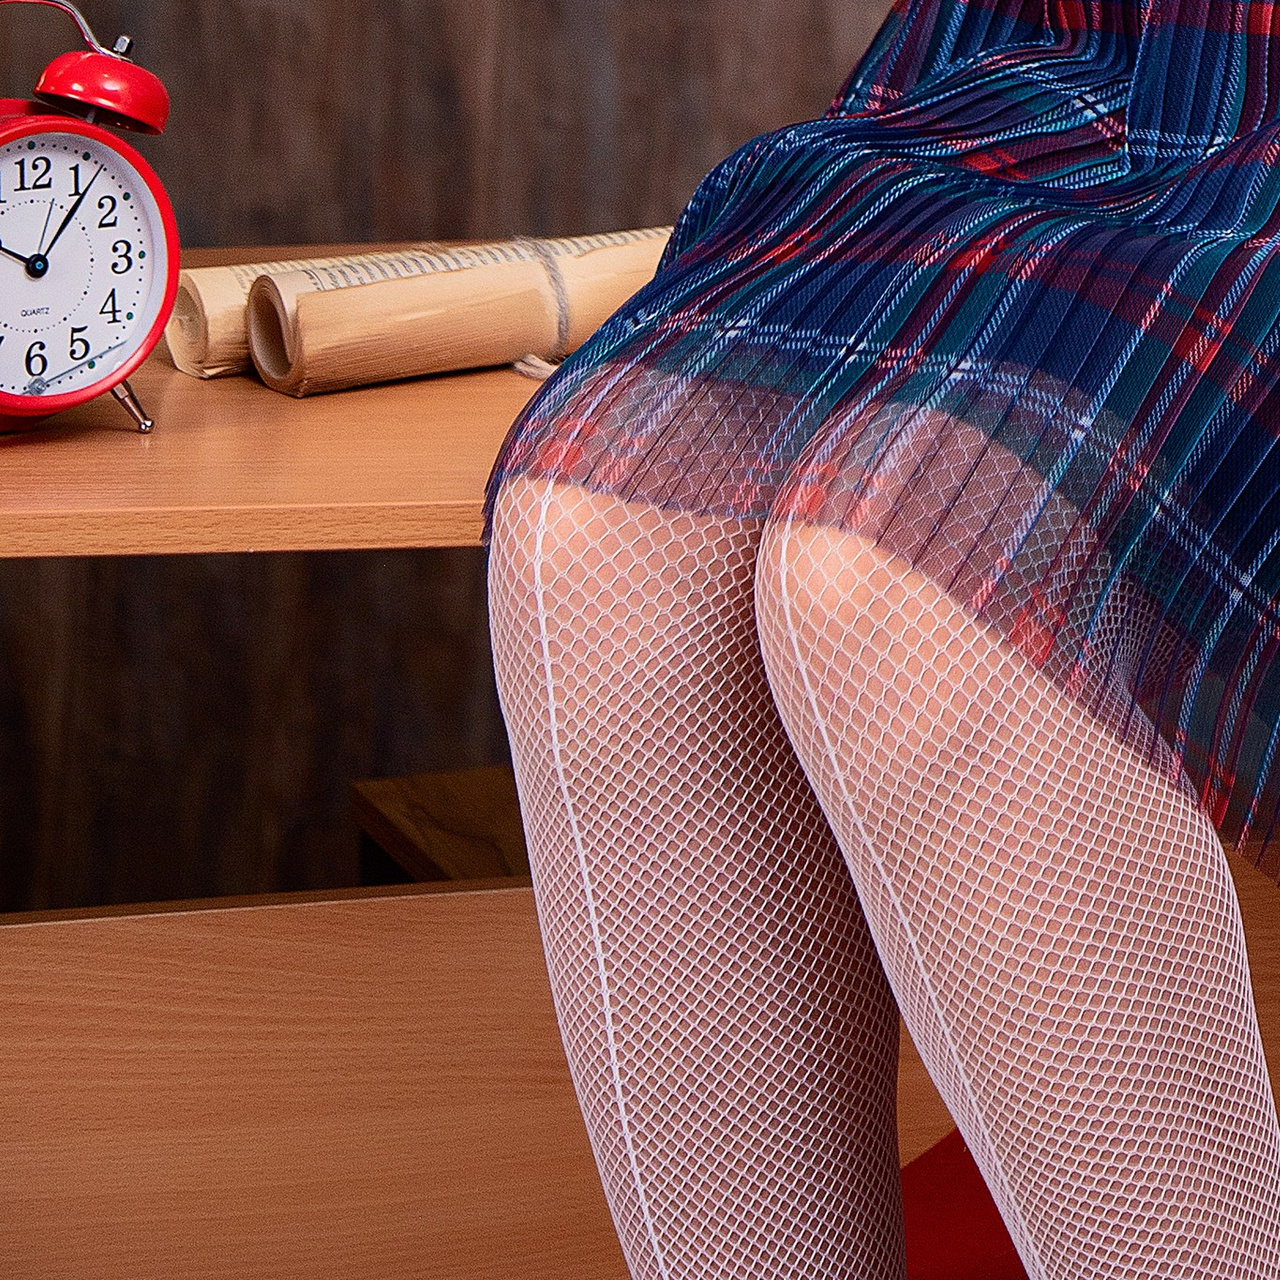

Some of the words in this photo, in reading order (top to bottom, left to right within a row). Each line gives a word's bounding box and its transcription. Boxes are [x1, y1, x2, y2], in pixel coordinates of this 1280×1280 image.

[14, 156, 52, 192] 12
[68, 164, 85, 197] 1
[97, 195, 118, 229] 2
[111, 240, 133, 274] 3
[99, 288, 122, 324] 4
[25, 341, 48, 377] 6
[69, 325, 90, 361] 5
